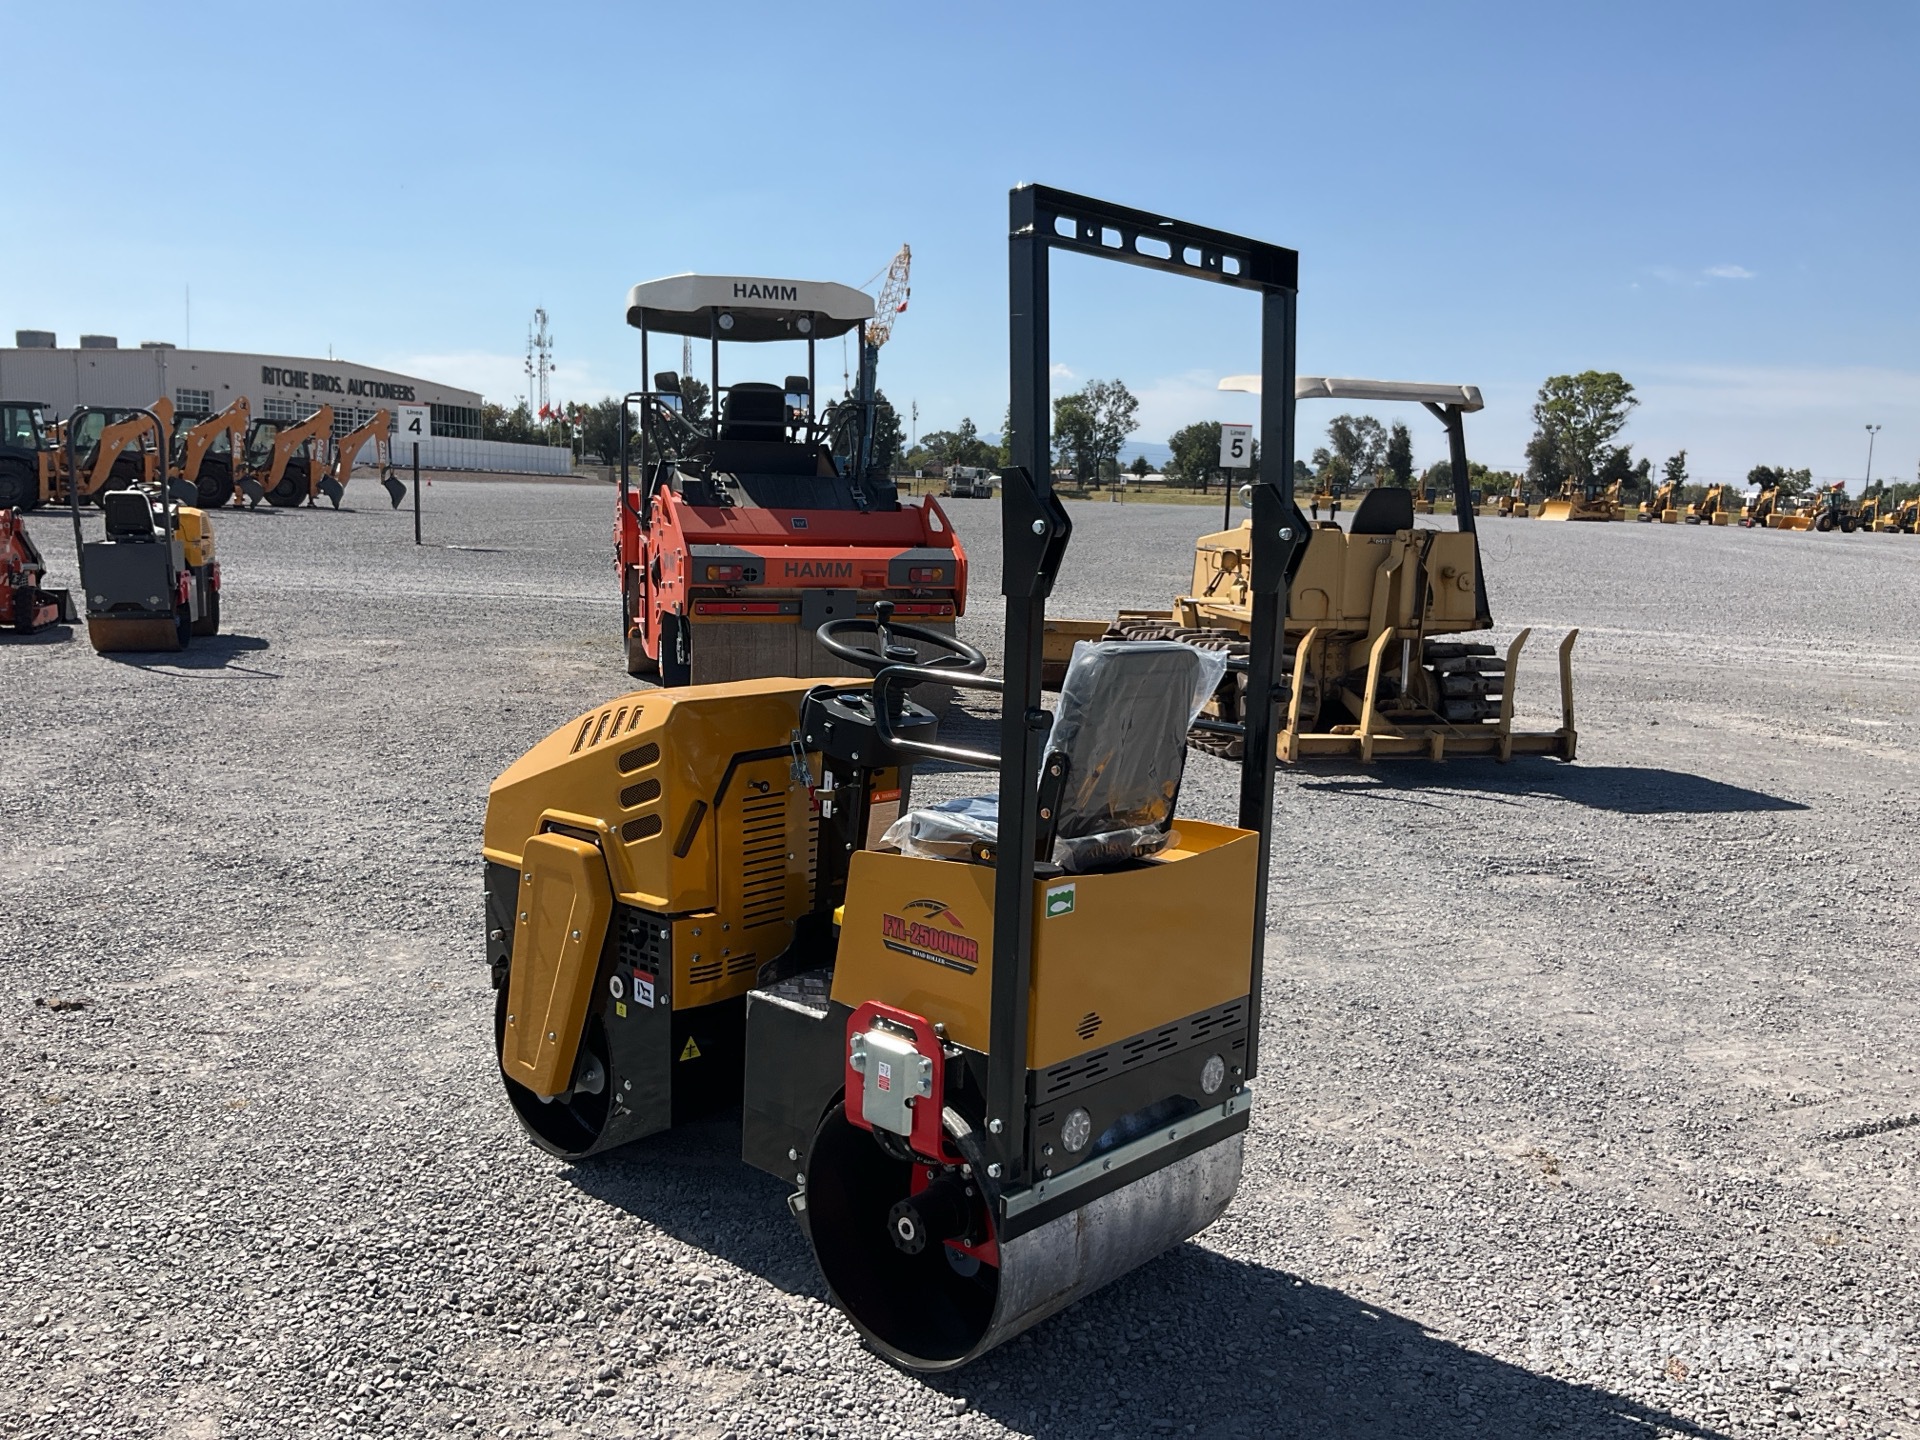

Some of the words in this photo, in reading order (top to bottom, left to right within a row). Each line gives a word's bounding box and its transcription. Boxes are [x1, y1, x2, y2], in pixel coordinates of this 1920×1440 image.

[733, 283, 797, 301] HAMM
[262, 366, 309, 389] RITCHIE
[312, 372, 345, 394] BROS.
[347, 378, 416, 402] AUCTIONEERS
[408, 417, 422, 435] 4
[234, 432, 242, 459] CASE
[316, 438, 324, 462] CASE
[1231, 438, 1243, 458] 5
[784, 562, 853, 577] HAMM
